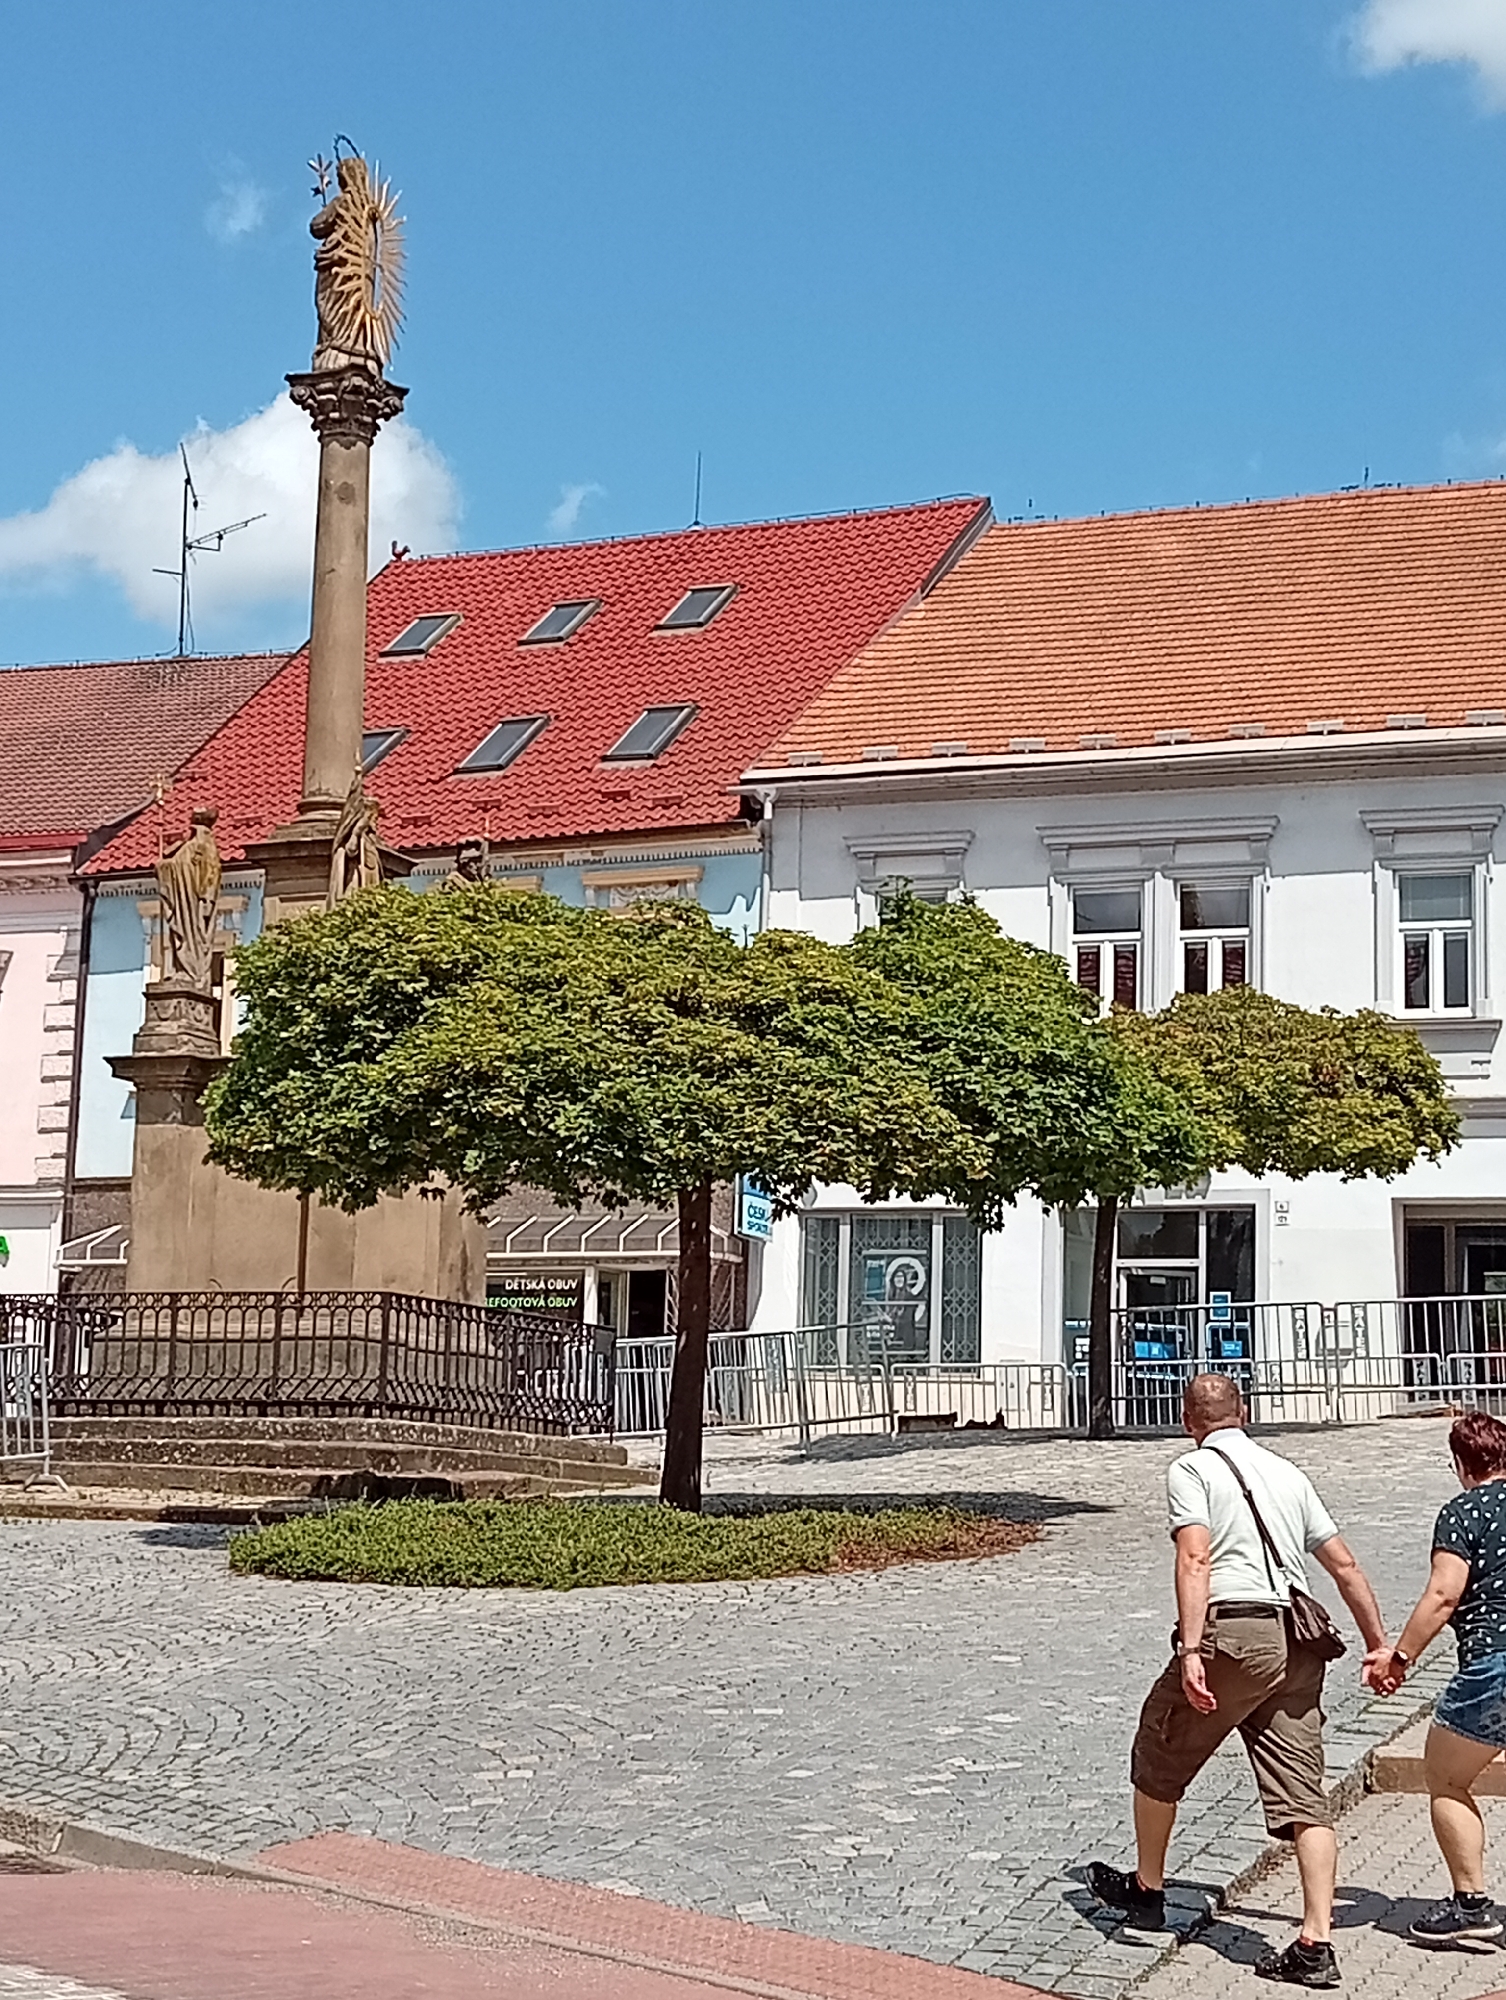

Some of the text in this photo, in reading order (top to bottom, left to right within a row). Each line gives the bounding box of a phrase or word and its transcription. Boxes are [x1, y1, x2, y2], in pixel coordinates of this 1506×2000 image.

[505, 1276, 578, 1290] DĚTSKÁ OBUV
[547, 1296, 578, 1308] OBUV
[1294, 1308, 1306, 1359] SATES
[1354, 1306, 1366, 1357] SATES
